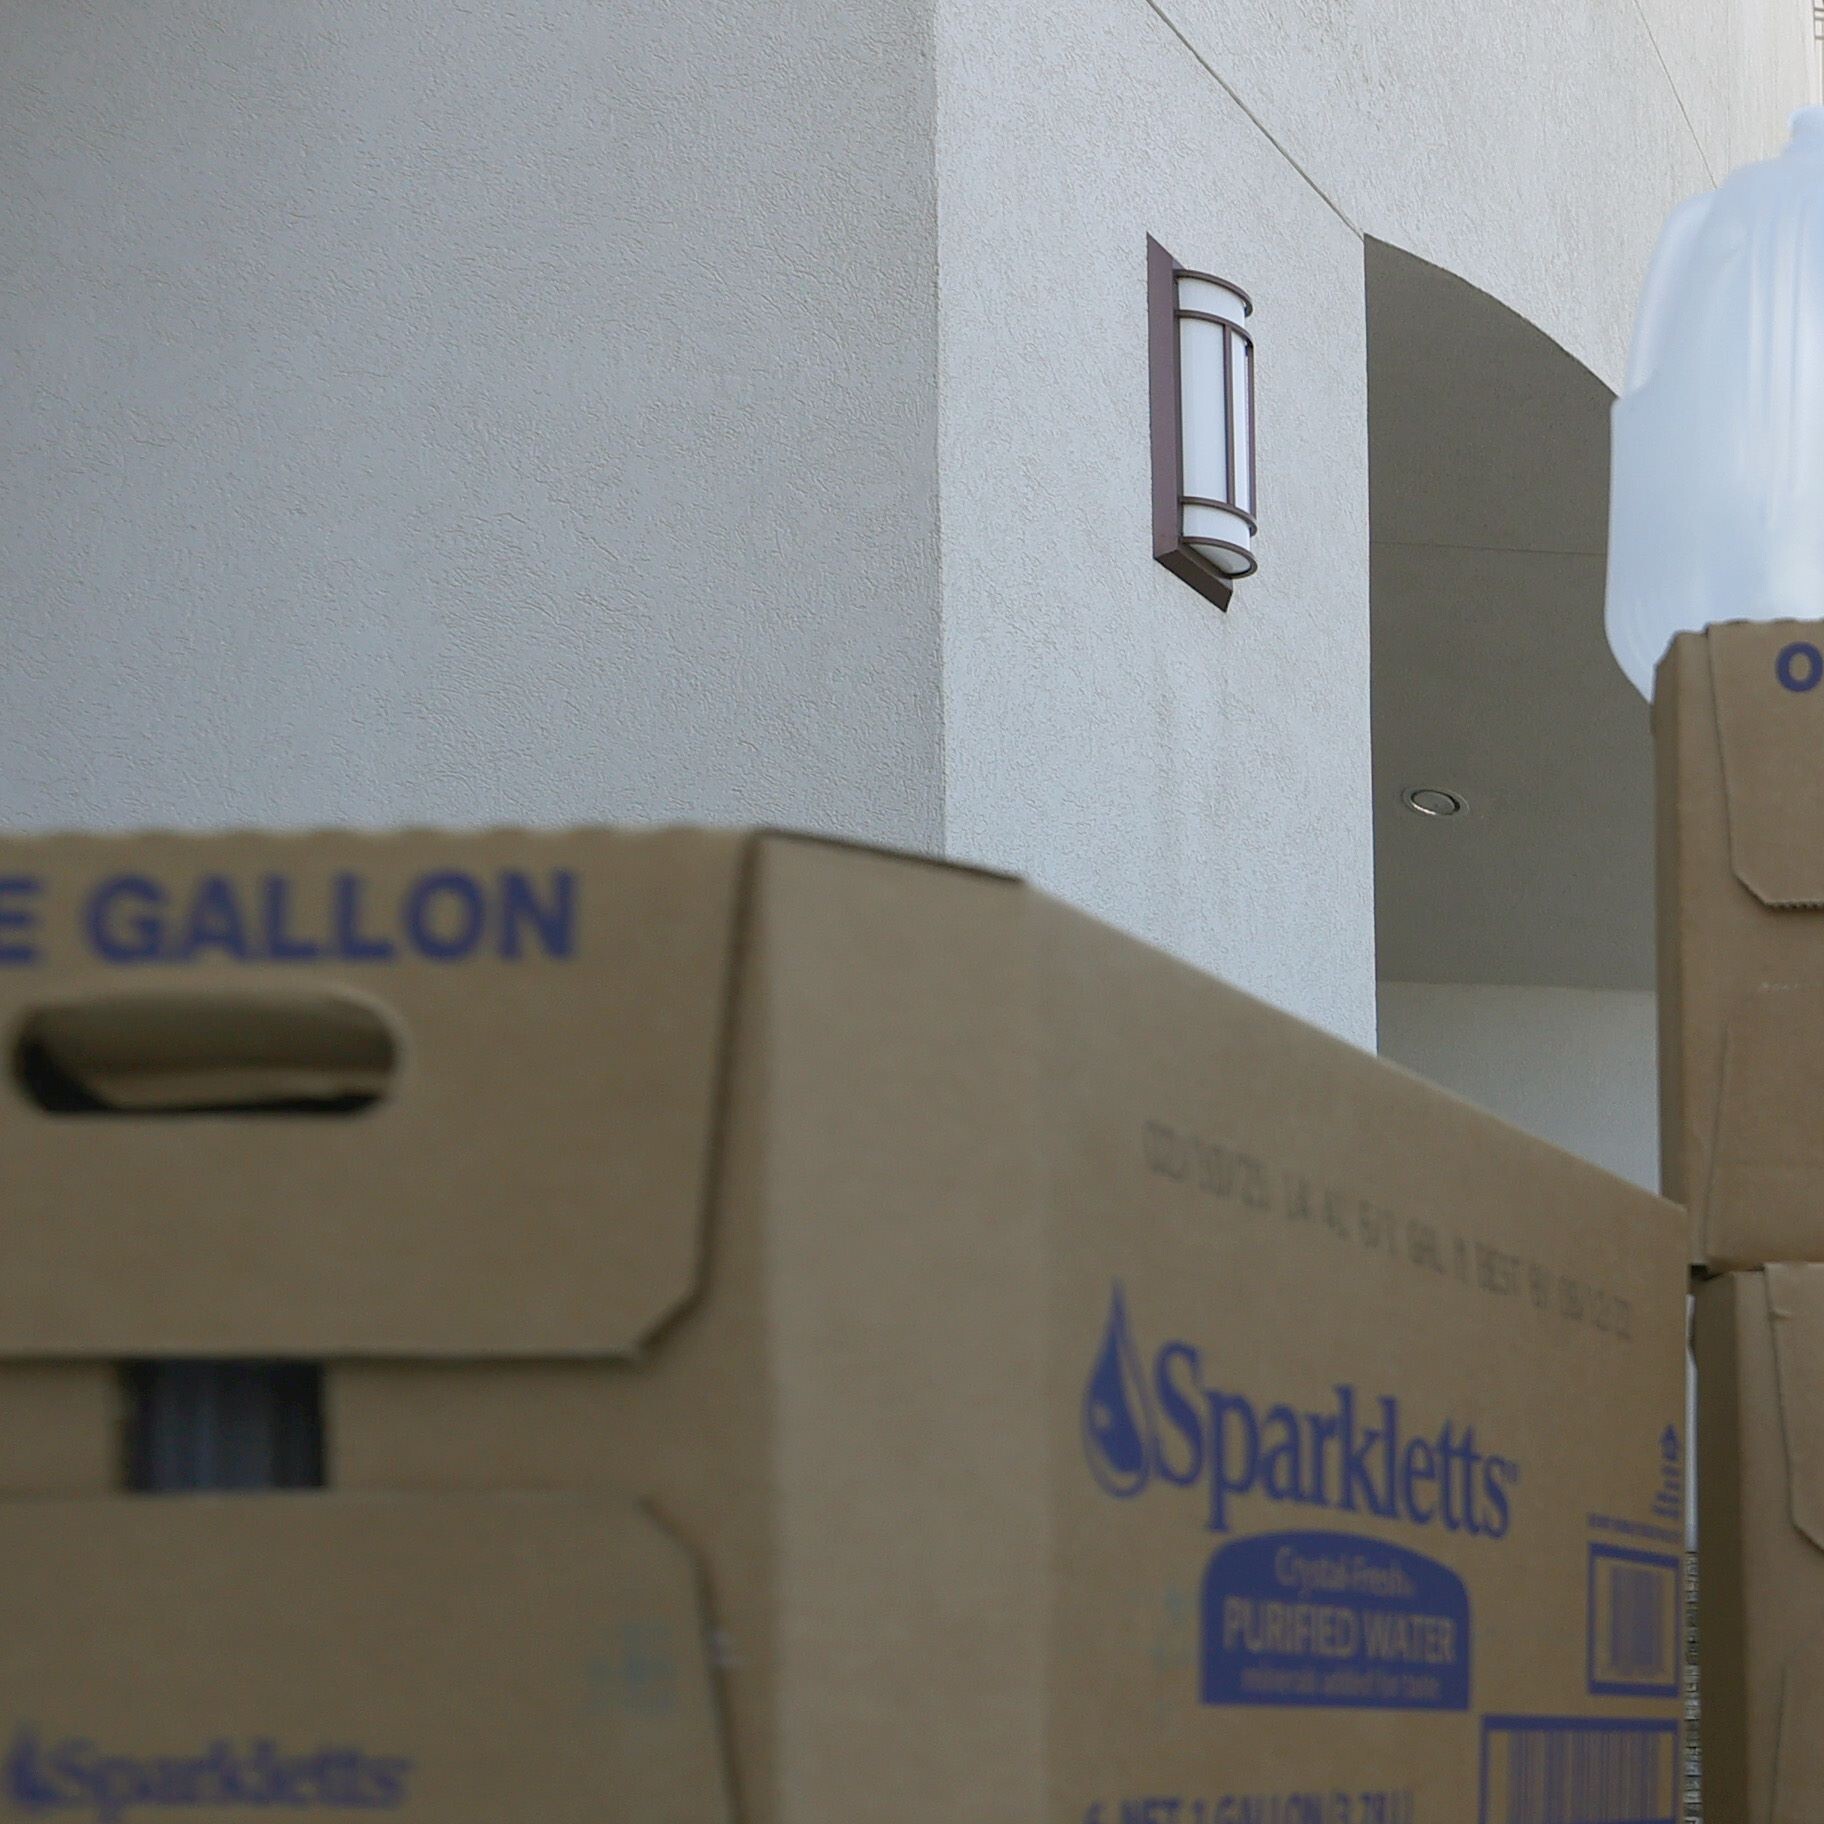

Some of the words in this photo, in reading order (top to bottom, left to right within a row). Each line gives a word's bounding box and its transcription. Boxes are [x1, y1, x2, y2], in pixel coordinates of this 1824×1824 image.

[84, 867, 581, 966] GALLON
[1153, 1340, 1511, 1540] Sparkletts
[1223, 1594, 1358, 1657] PURIFIED
[1363, 1610, 1457, 1664] WATER
